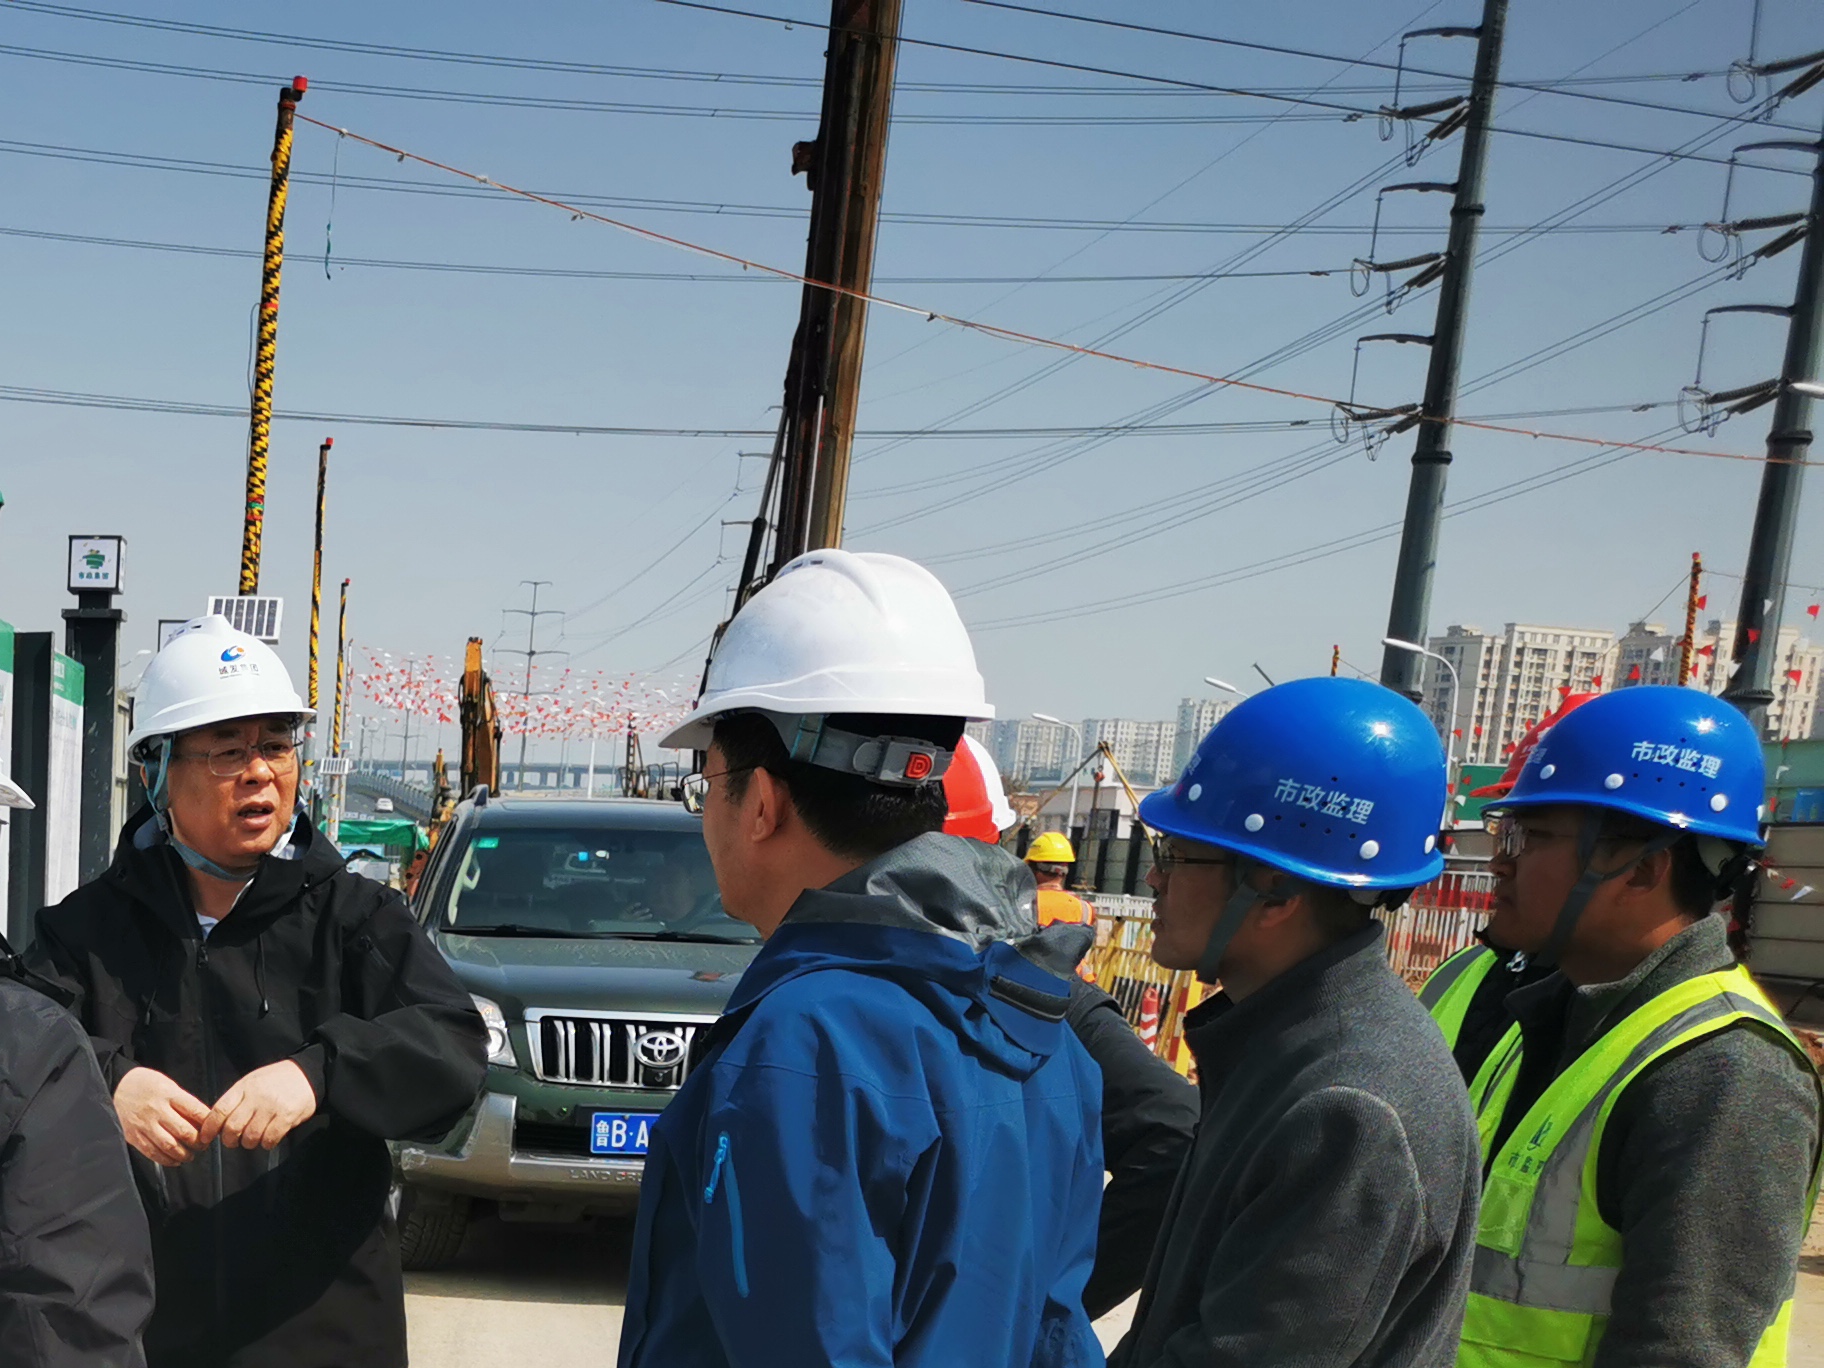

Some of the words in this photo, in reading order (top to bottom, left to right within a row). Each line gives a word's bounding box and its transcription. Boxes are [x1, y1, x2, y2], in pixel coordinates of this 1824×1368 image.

[1630, 740, 1723, 779] 市政监理
[1274, 777, 1375, 825] 市政监理
